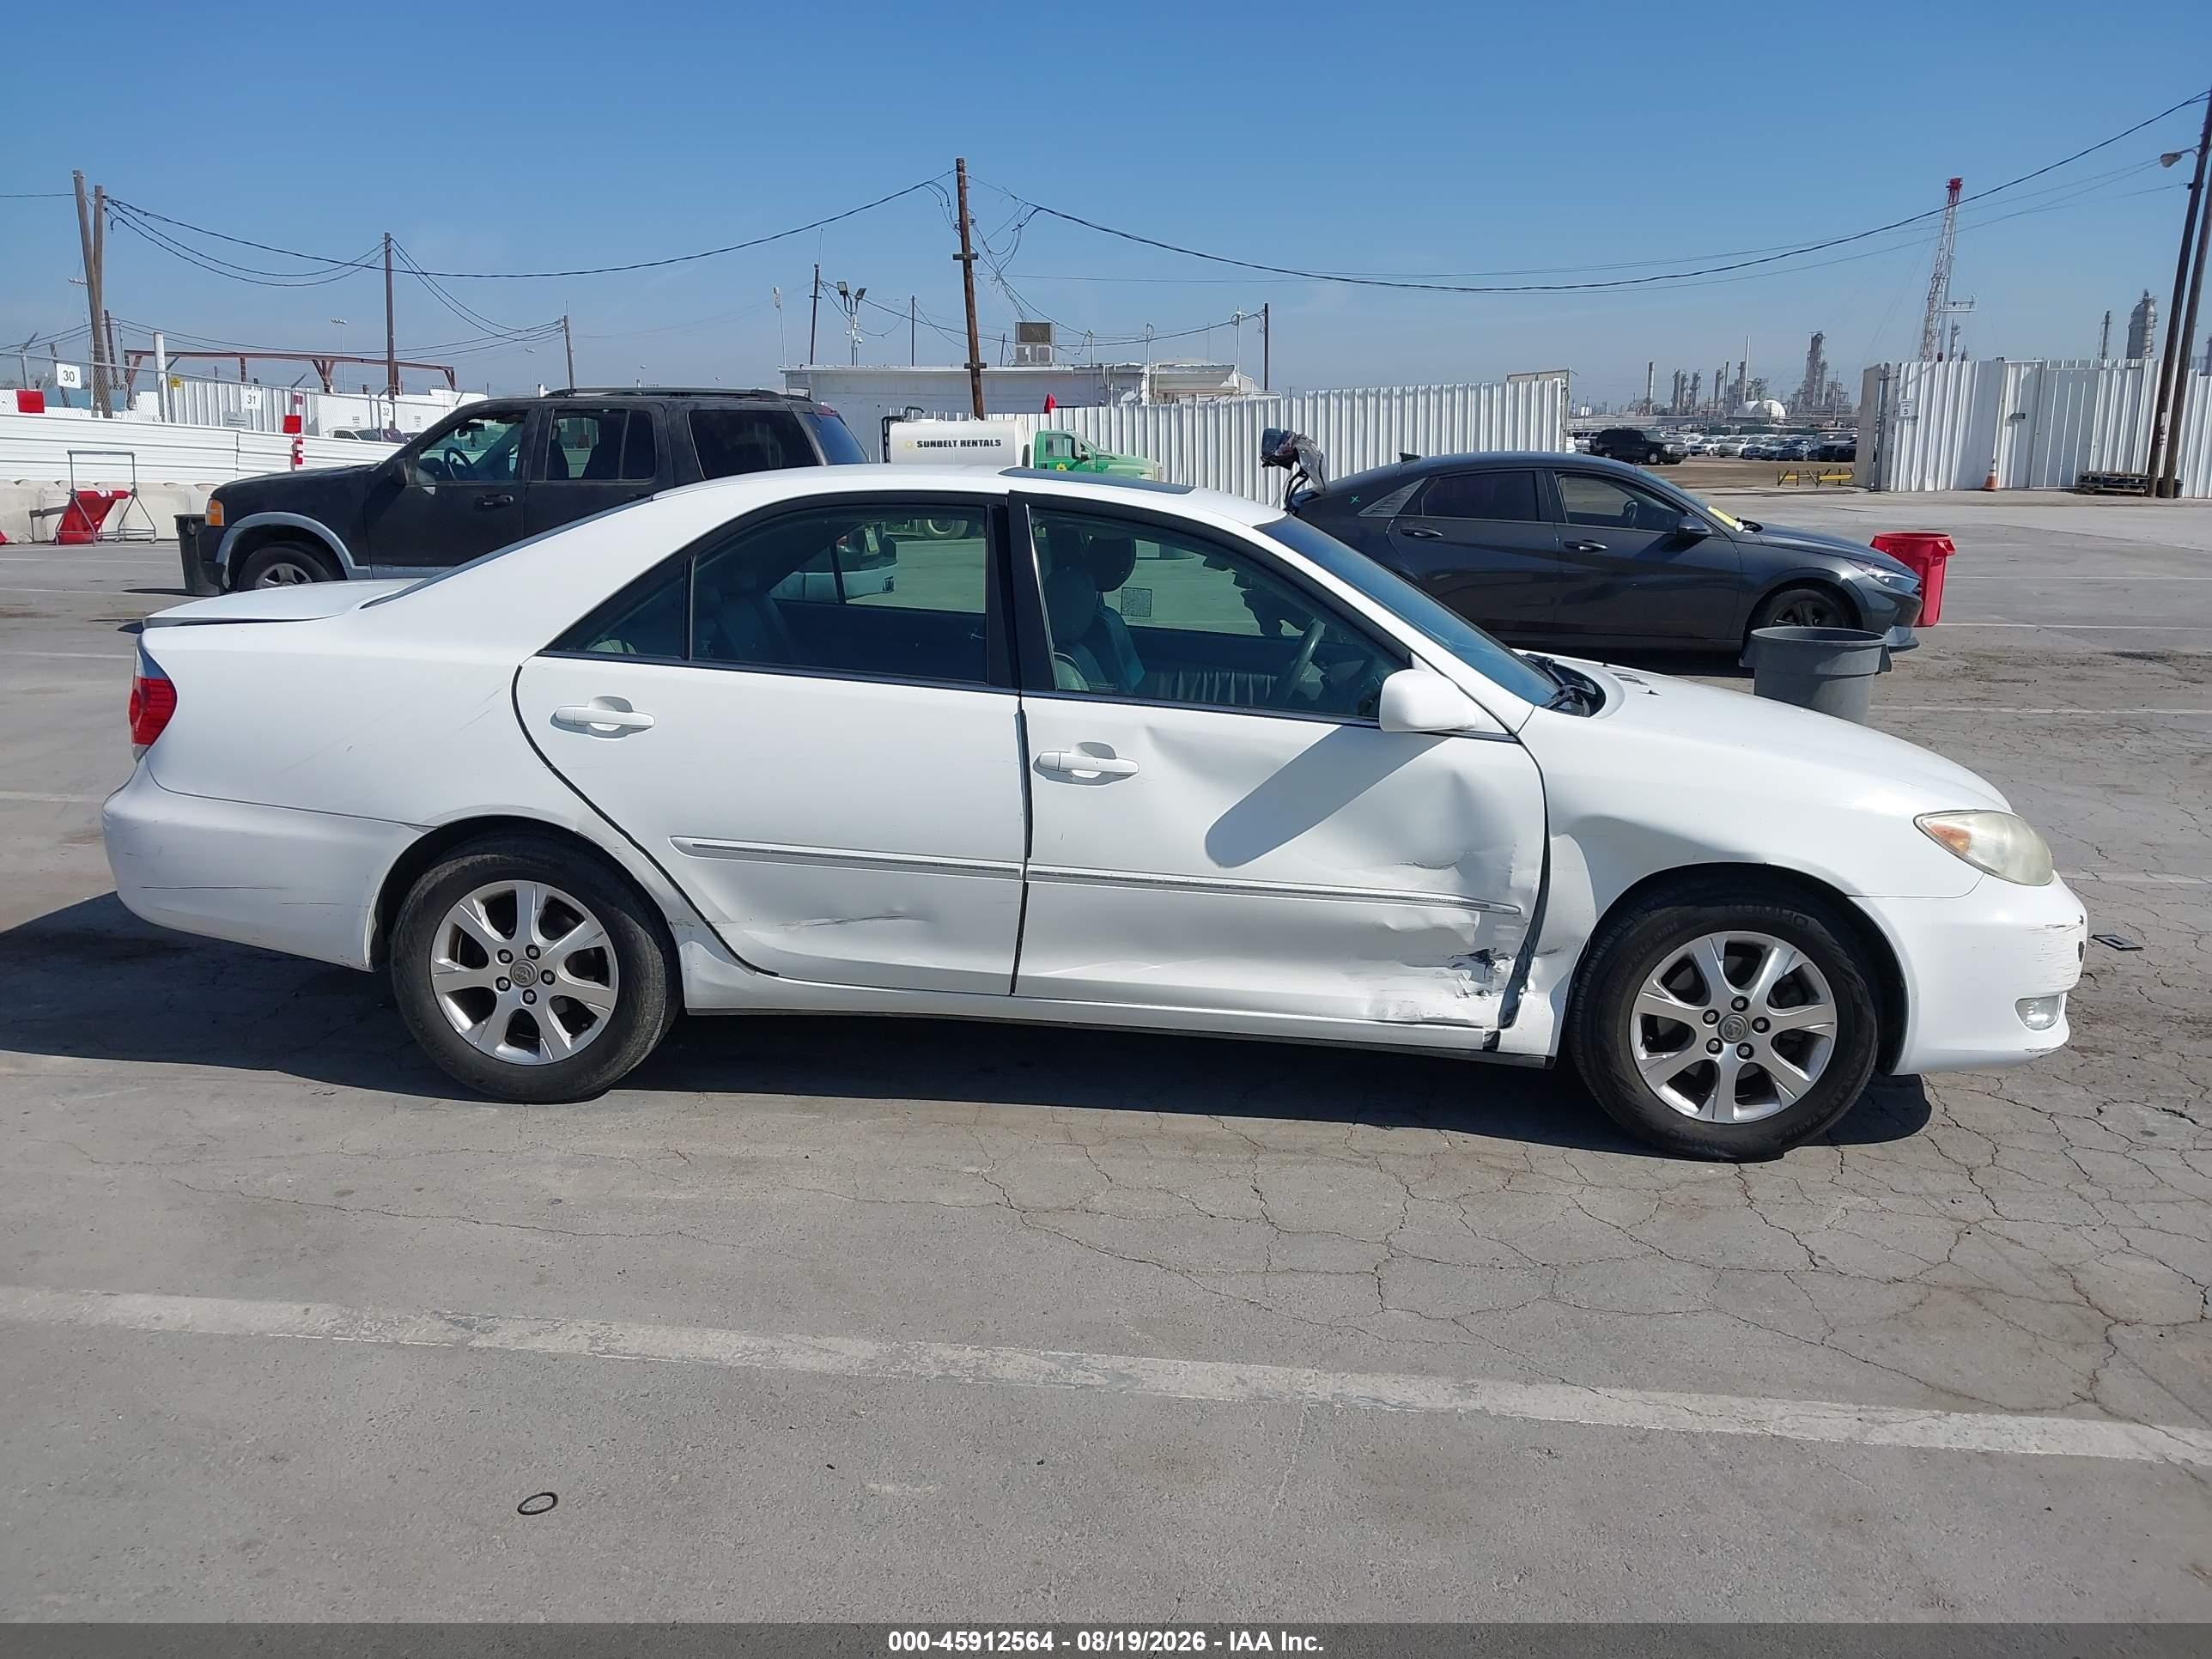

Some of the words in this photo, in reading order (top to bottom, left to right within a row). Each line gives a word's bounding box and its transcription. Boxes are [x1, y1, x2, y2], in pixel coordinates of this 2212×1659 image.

[63, 370, 76, 382] 30
[246, 395, 256, 404] 31
[382, 407, 390, 416] 32
[960, 439, 1001, 447] RENTALS
